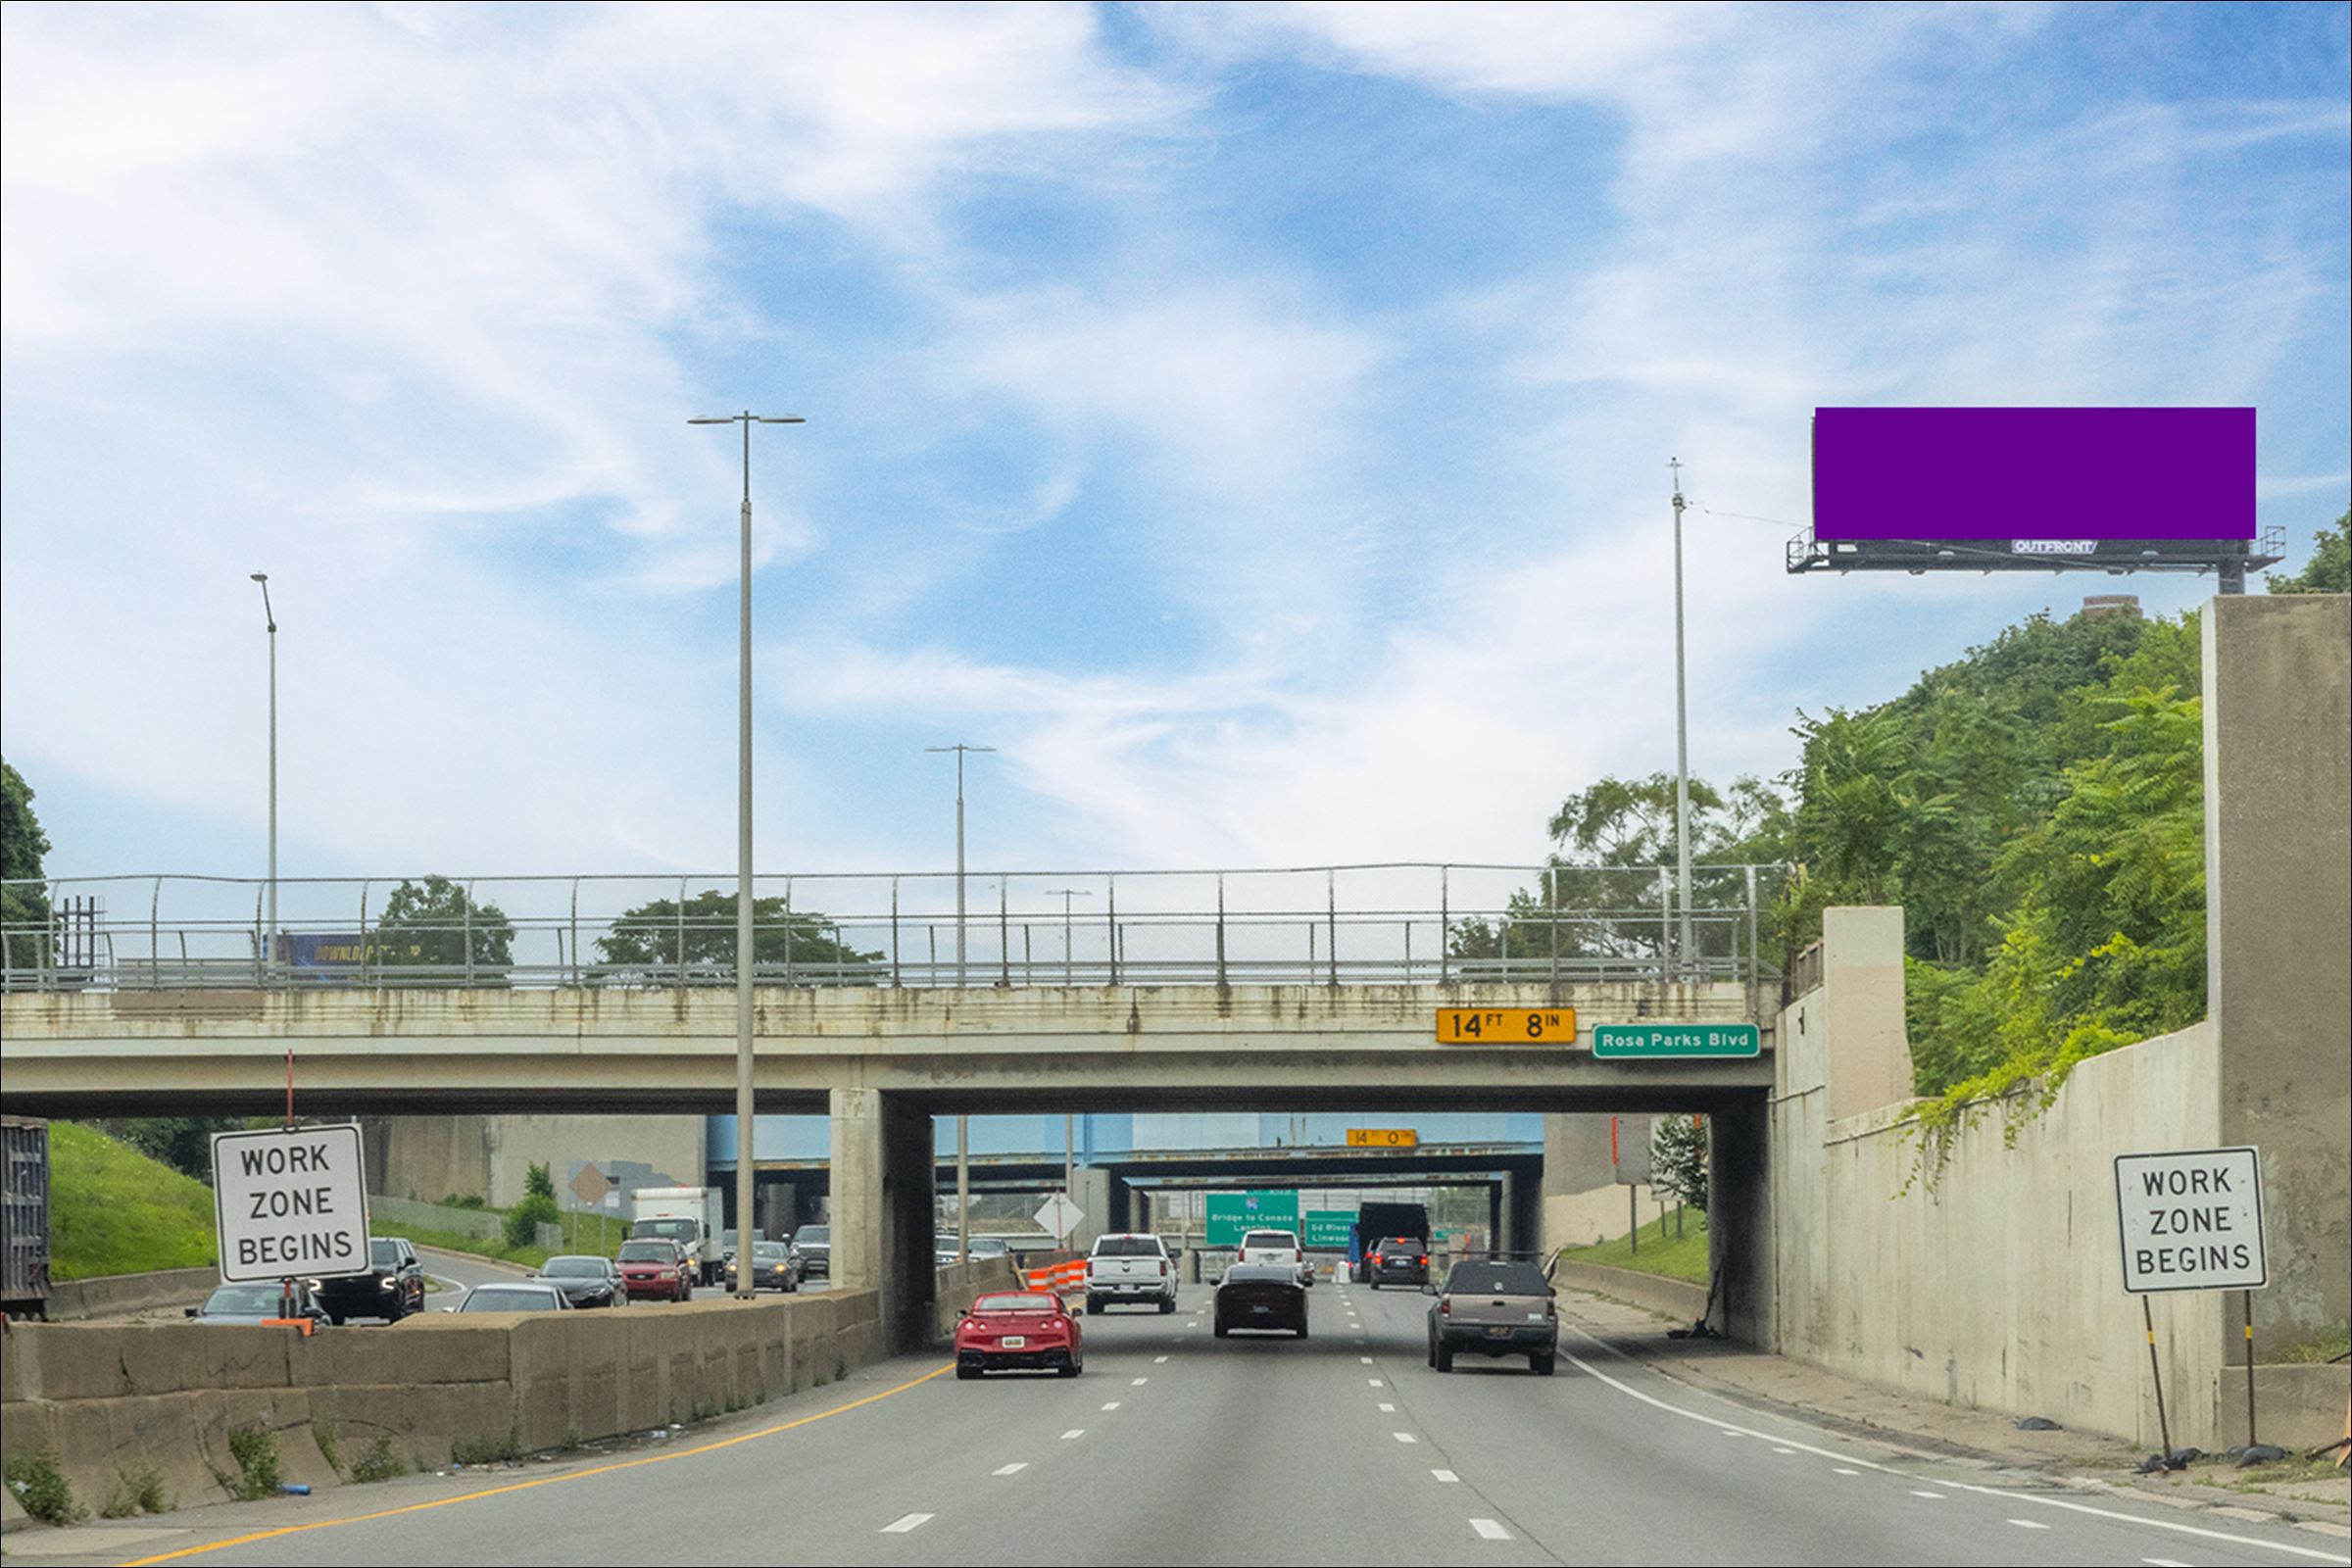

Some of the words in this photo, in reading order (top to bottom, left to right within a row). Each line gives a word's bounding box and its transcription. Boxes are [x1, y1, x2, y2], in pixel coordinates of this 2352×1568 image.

[2015, 541, 2093, 554] OUTFRONT
[1452, 1013, 1482, 1038] 14
[1486, 1013, 1503, 1026] FT
[1527, 1013, 1543, 1038] 8
[1545, 1013, 1560, 1027] IN
[1602, 1033, 1644, 1047] Rosa
[1651, 1033, 1702, 1047] Parks
[1708, 1032, 1748, 1047] Blvd
[1355, 1131, 1367, 1145] 14
[240, 1144, 330, 1177] WORK
[2142, 1167, 2232, 1198] WORK
[249, 1187, 334, 1219] ZONE
[2149, 1206, 2233, 1236] ZONE
[238, 1231, 353, 1265] BEGINS
[2136, 1244, 2250, 1275] BEGINS
